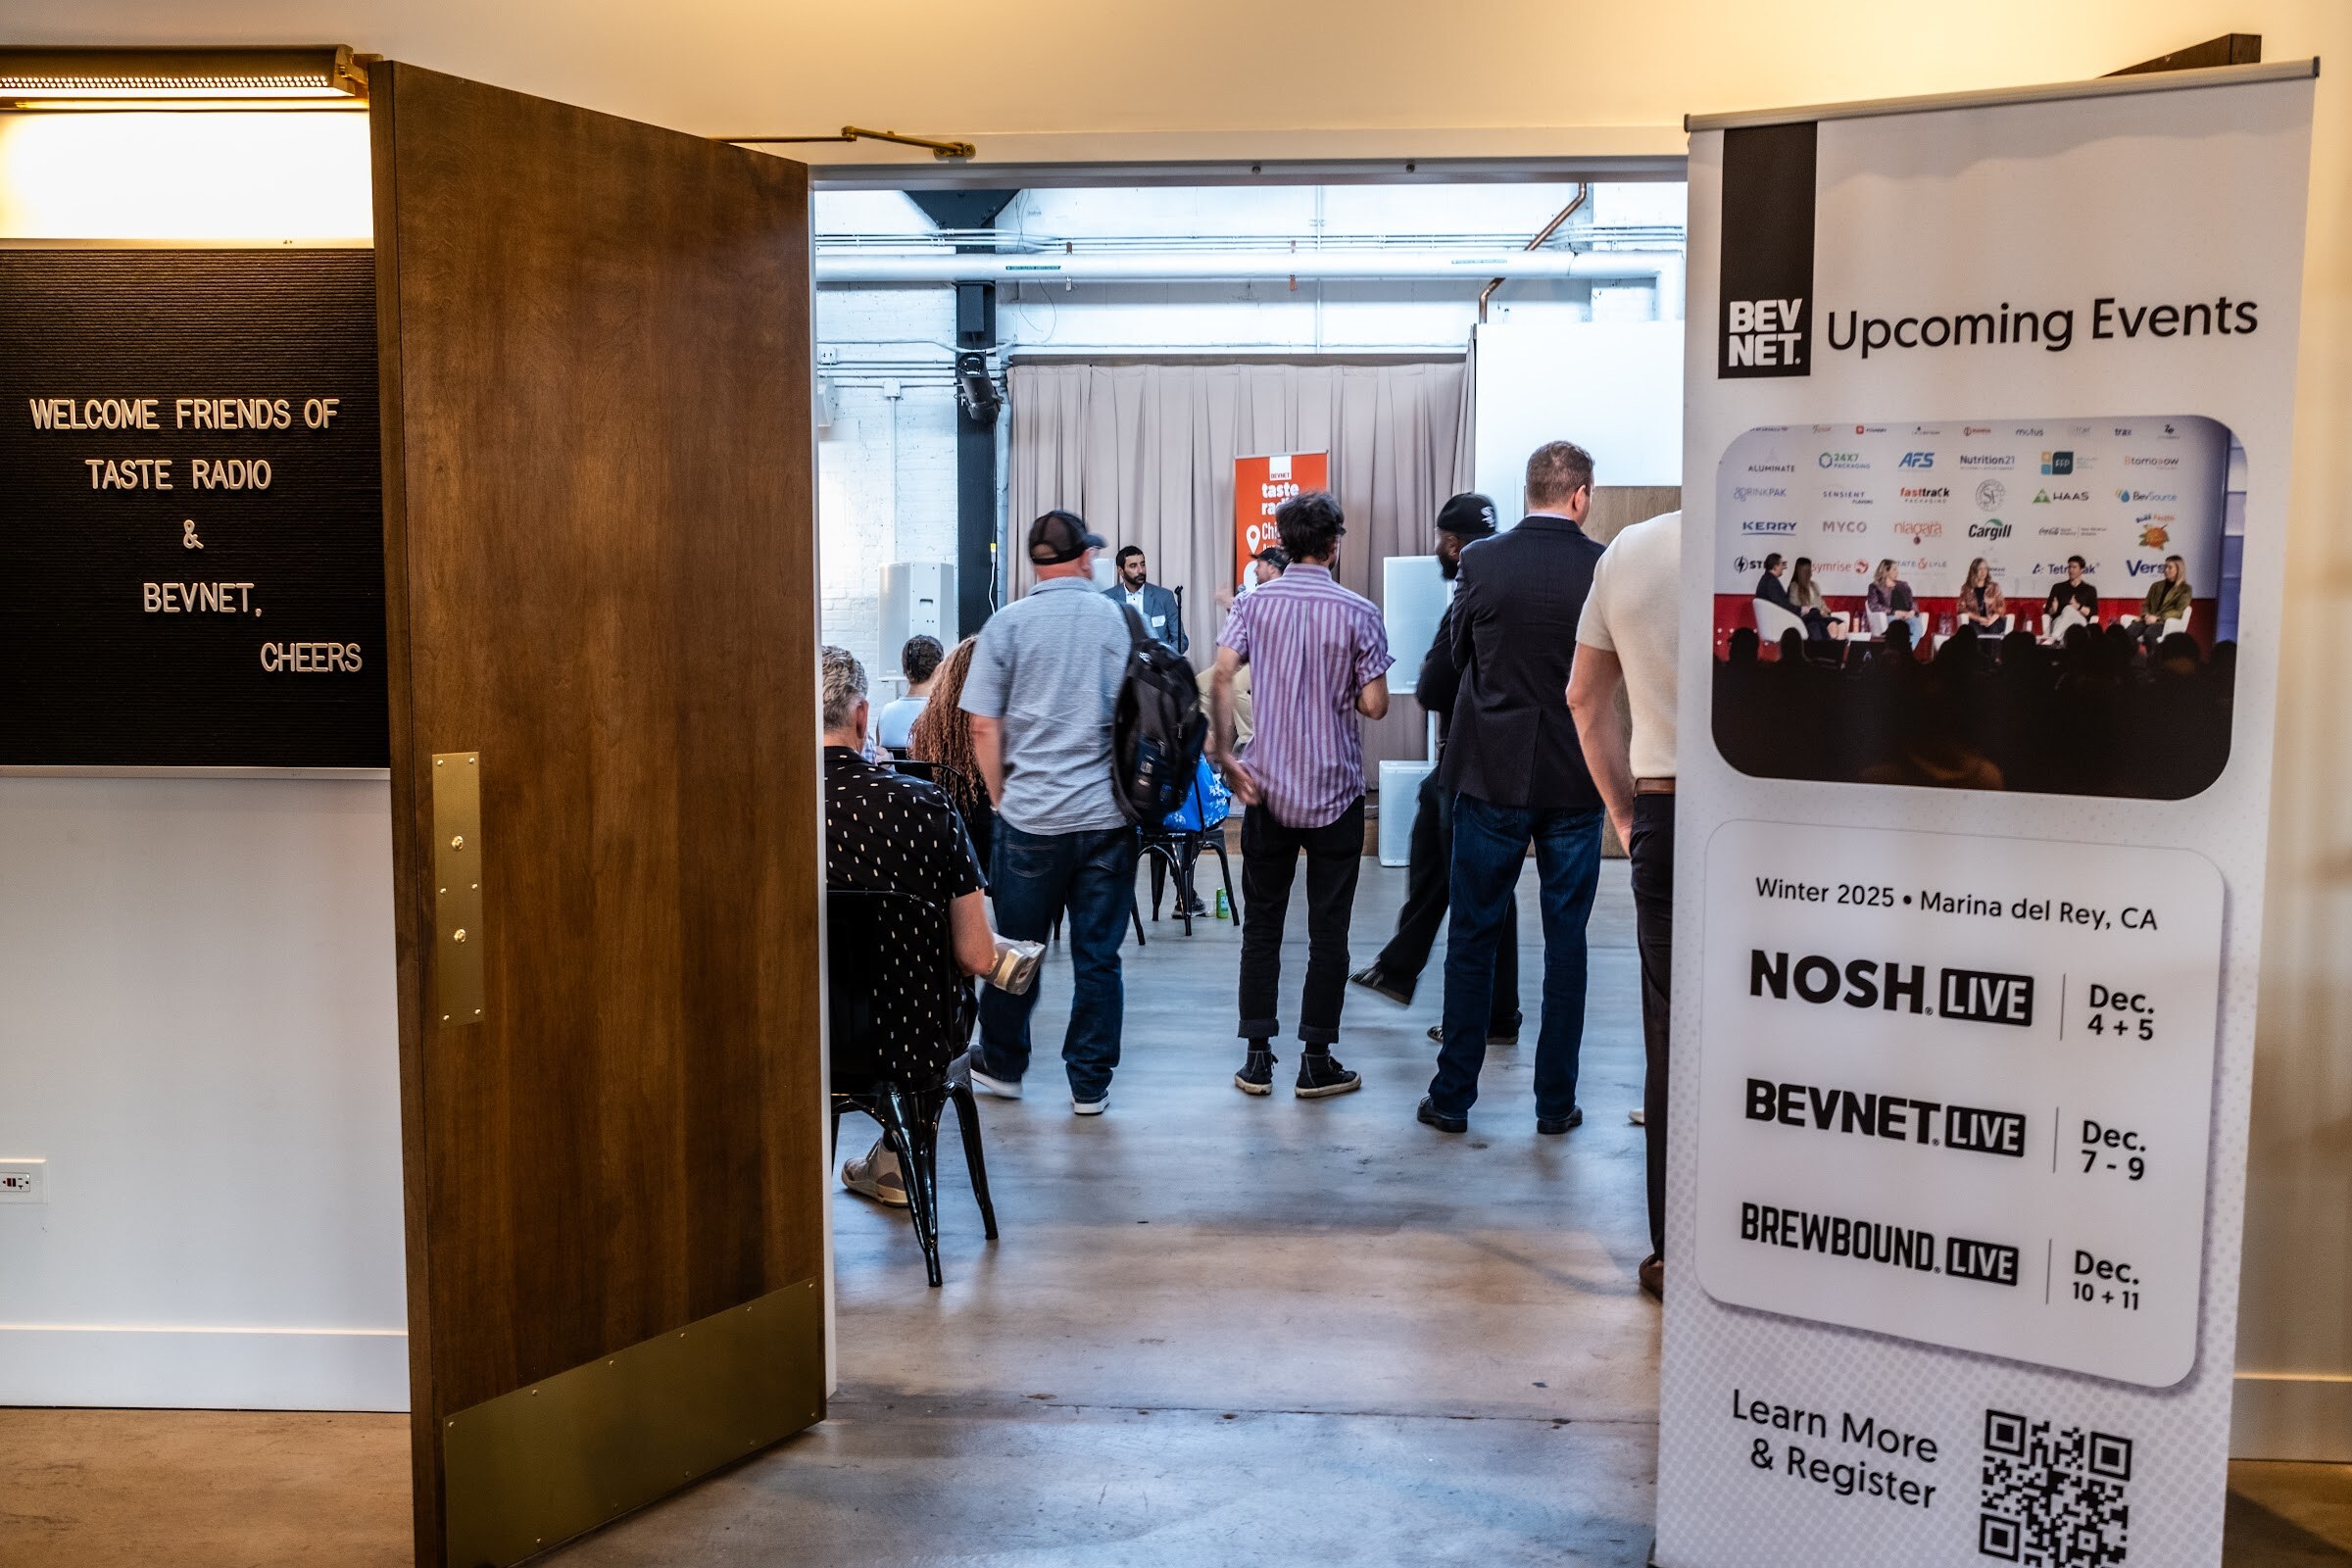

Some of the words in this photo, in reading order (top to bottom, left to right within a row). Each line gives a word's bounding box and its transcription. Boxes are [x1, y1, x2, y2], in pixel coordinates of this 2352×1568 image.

[1729, 298, 1803, 333] BEV
[1828, 301, 2075, 360] Upcoming
[2091, 297, 2260, 341] Events
[29, 399, 160, 429] WELCOME
[175, 399, 291, 429] FRIENDS
[304, 398, 340, 429] OF
[85, 459, 172, 490] TASTE
[192, 459, 272, 490] RADIO
[1747, 465, 1795, 473] ALUMINATE
[1898, 452, 1936, 468] AFS
[1261, 482, 1299, 498] taste
[183, 519, 204, 549] &
[1742, 521, 1797, 531] KERRY
[1823, 521, 1867, 533] MYCO
[1968, 524, 2012, 541] Cargill
[143, 583, 262, 617] BEVNET,
[260, 643, 363, 672] CHEERS
[1755, 877, 1830, 903] Winter
[1837, 884, 1894, 907] 2025
[1920, 891, 2002, 917] Marina
[2011, 899, 2050, 921] del
[2059, 902, 2111, 931] Rey,
[2121, 907, 2158, 931] CA
[1946, 975, 2027, 1020] LIVE
[2089, 984, 2154, 1014] Dec.
[2087, 1013, 2104, 1036] 4
[2113, 1020, 2129, 1036] +
[2138, 1018, 2153, 1041] 5
[1951, 1110, 2020, 1152] LIVE
[2082, 1120, 2146, 1152] Dec.
[2082, 1150, 2096, 1173] 7
[2128, 1156, 2144, 1181] 9
[1951, 1243, 2015, 1281] LIVE
[2075, 1250, 2139, 1285] Dec.
[2073, 1282, 2094, 1301] 10
[2101, 1291, 2115, 1304] +
[2122, 1291, 2139, 1310] 11
[1733, 1390, 1827, 1439] Learn
[1842, 1411, 1938, 1463] More
[1749, 1438, 1774, 1470] &
[1788, 1446, 1937, 1509] Register
